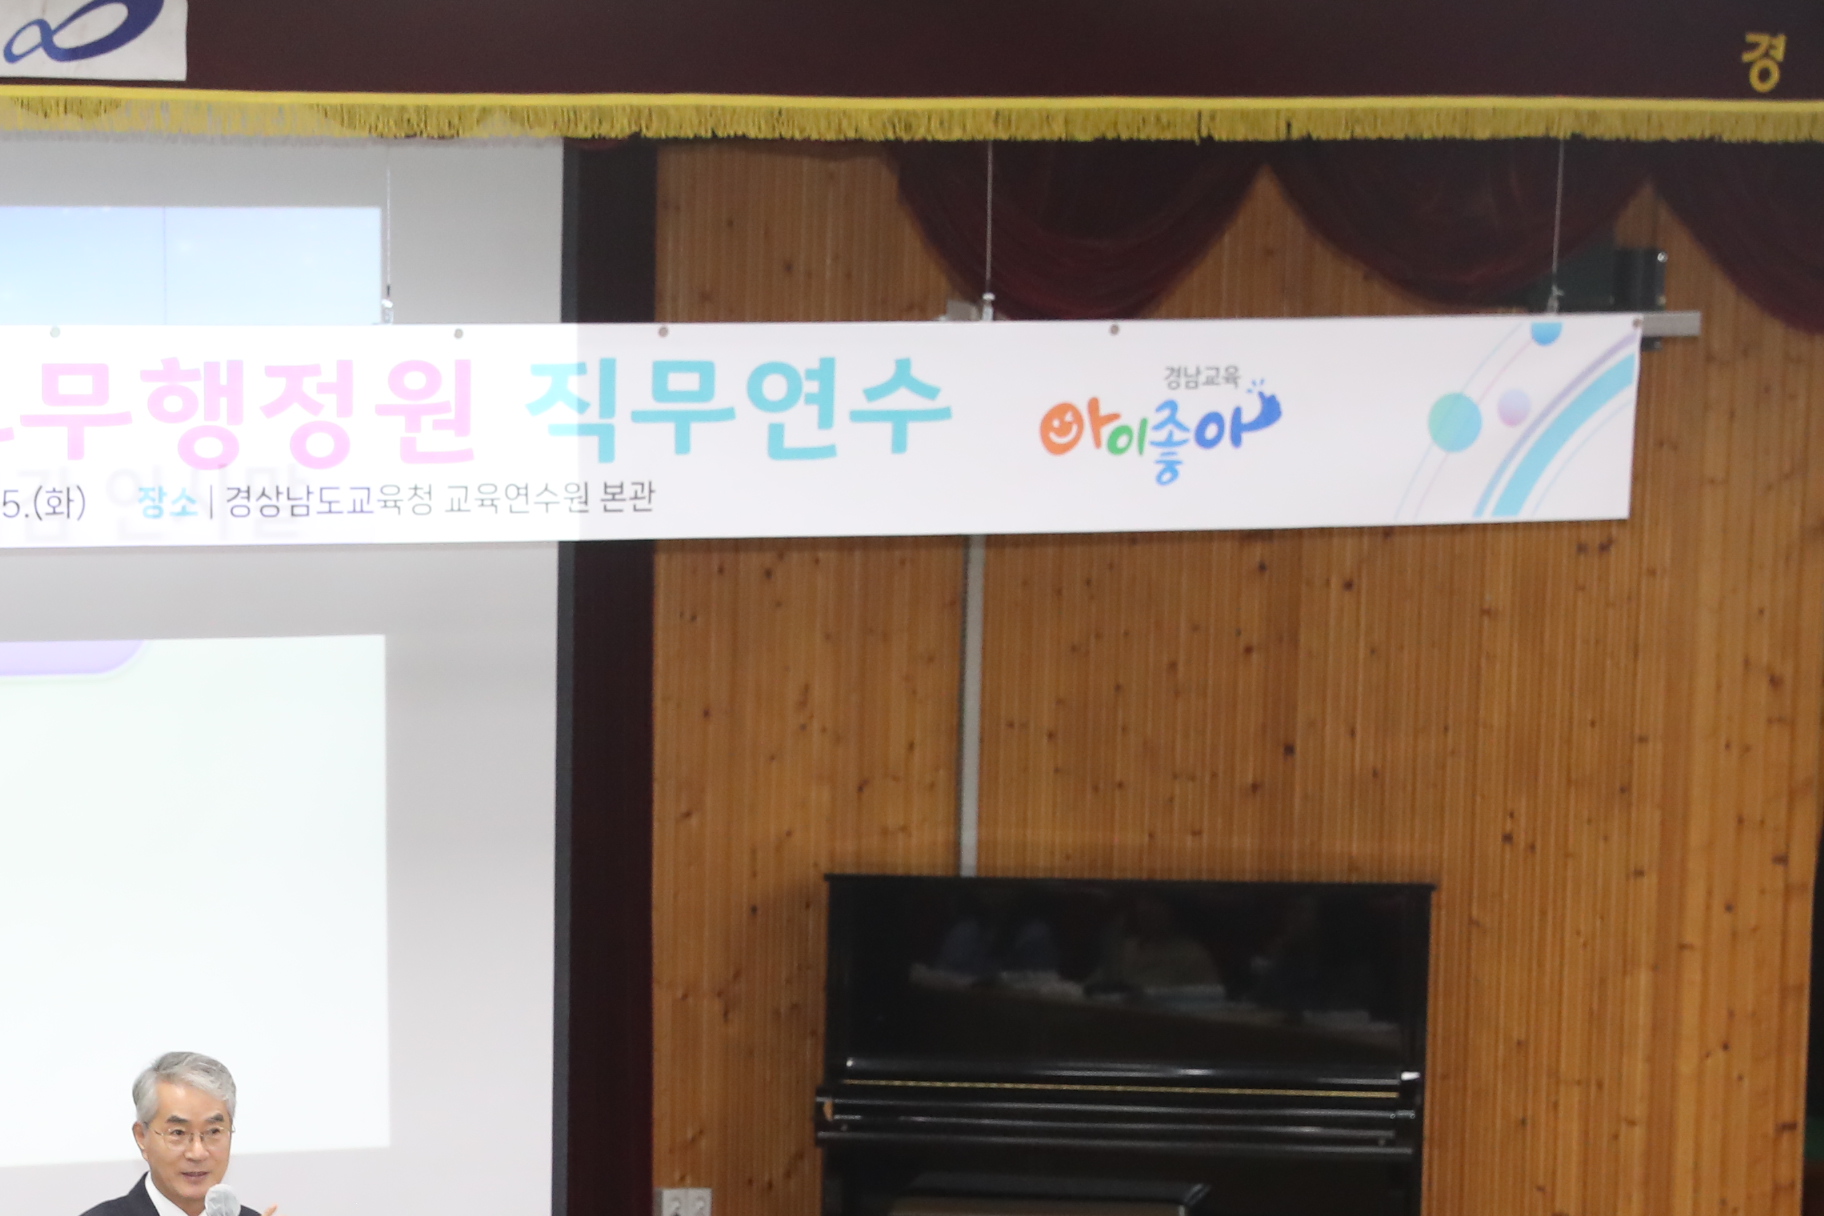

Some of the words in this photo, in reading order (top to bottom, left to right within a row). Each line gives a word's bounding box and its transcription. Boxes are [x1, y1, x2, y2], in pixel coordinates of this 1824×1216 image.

[1741, 31, 1788, 93] 경
[1164, 365, 1241, 390] 경남교육
[526, 356, 953, 463] 직무연수
[1039, 391, 1283, 487] 아이좋아
[138, 485, 198, 519] 장소
[226, 484, 433, 518] 경상남도교육청
[447, 481, 591, 514] 교육연수원
[601, 481, 656, 513] 본관
